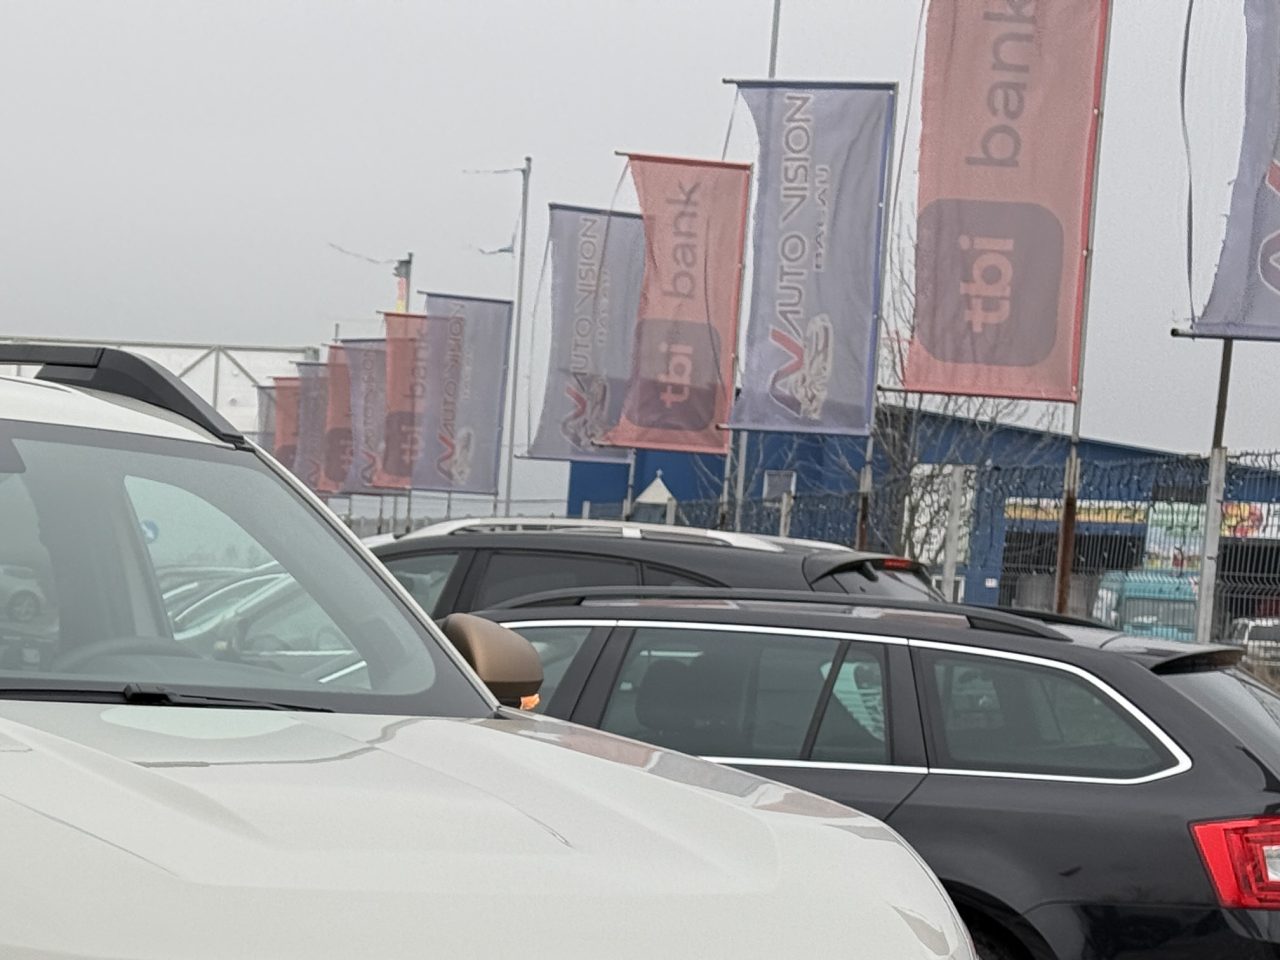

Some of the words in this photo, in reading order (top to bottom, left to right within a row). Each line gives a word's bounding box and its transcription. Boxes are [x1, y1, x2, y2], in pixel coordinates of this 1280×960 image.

[965, 0, 1038, 168] bank
[782, 93, 812, 222] VISION
[576, 217, 599, 310] VISION
[664, 181, 702, 302] bank
[777, 233, 806, 336] AUTO
[959, 235, 1015, 333] tbi
[571, 318, 593, 392] AUTO
[659, 343, 694, 408] tbi
